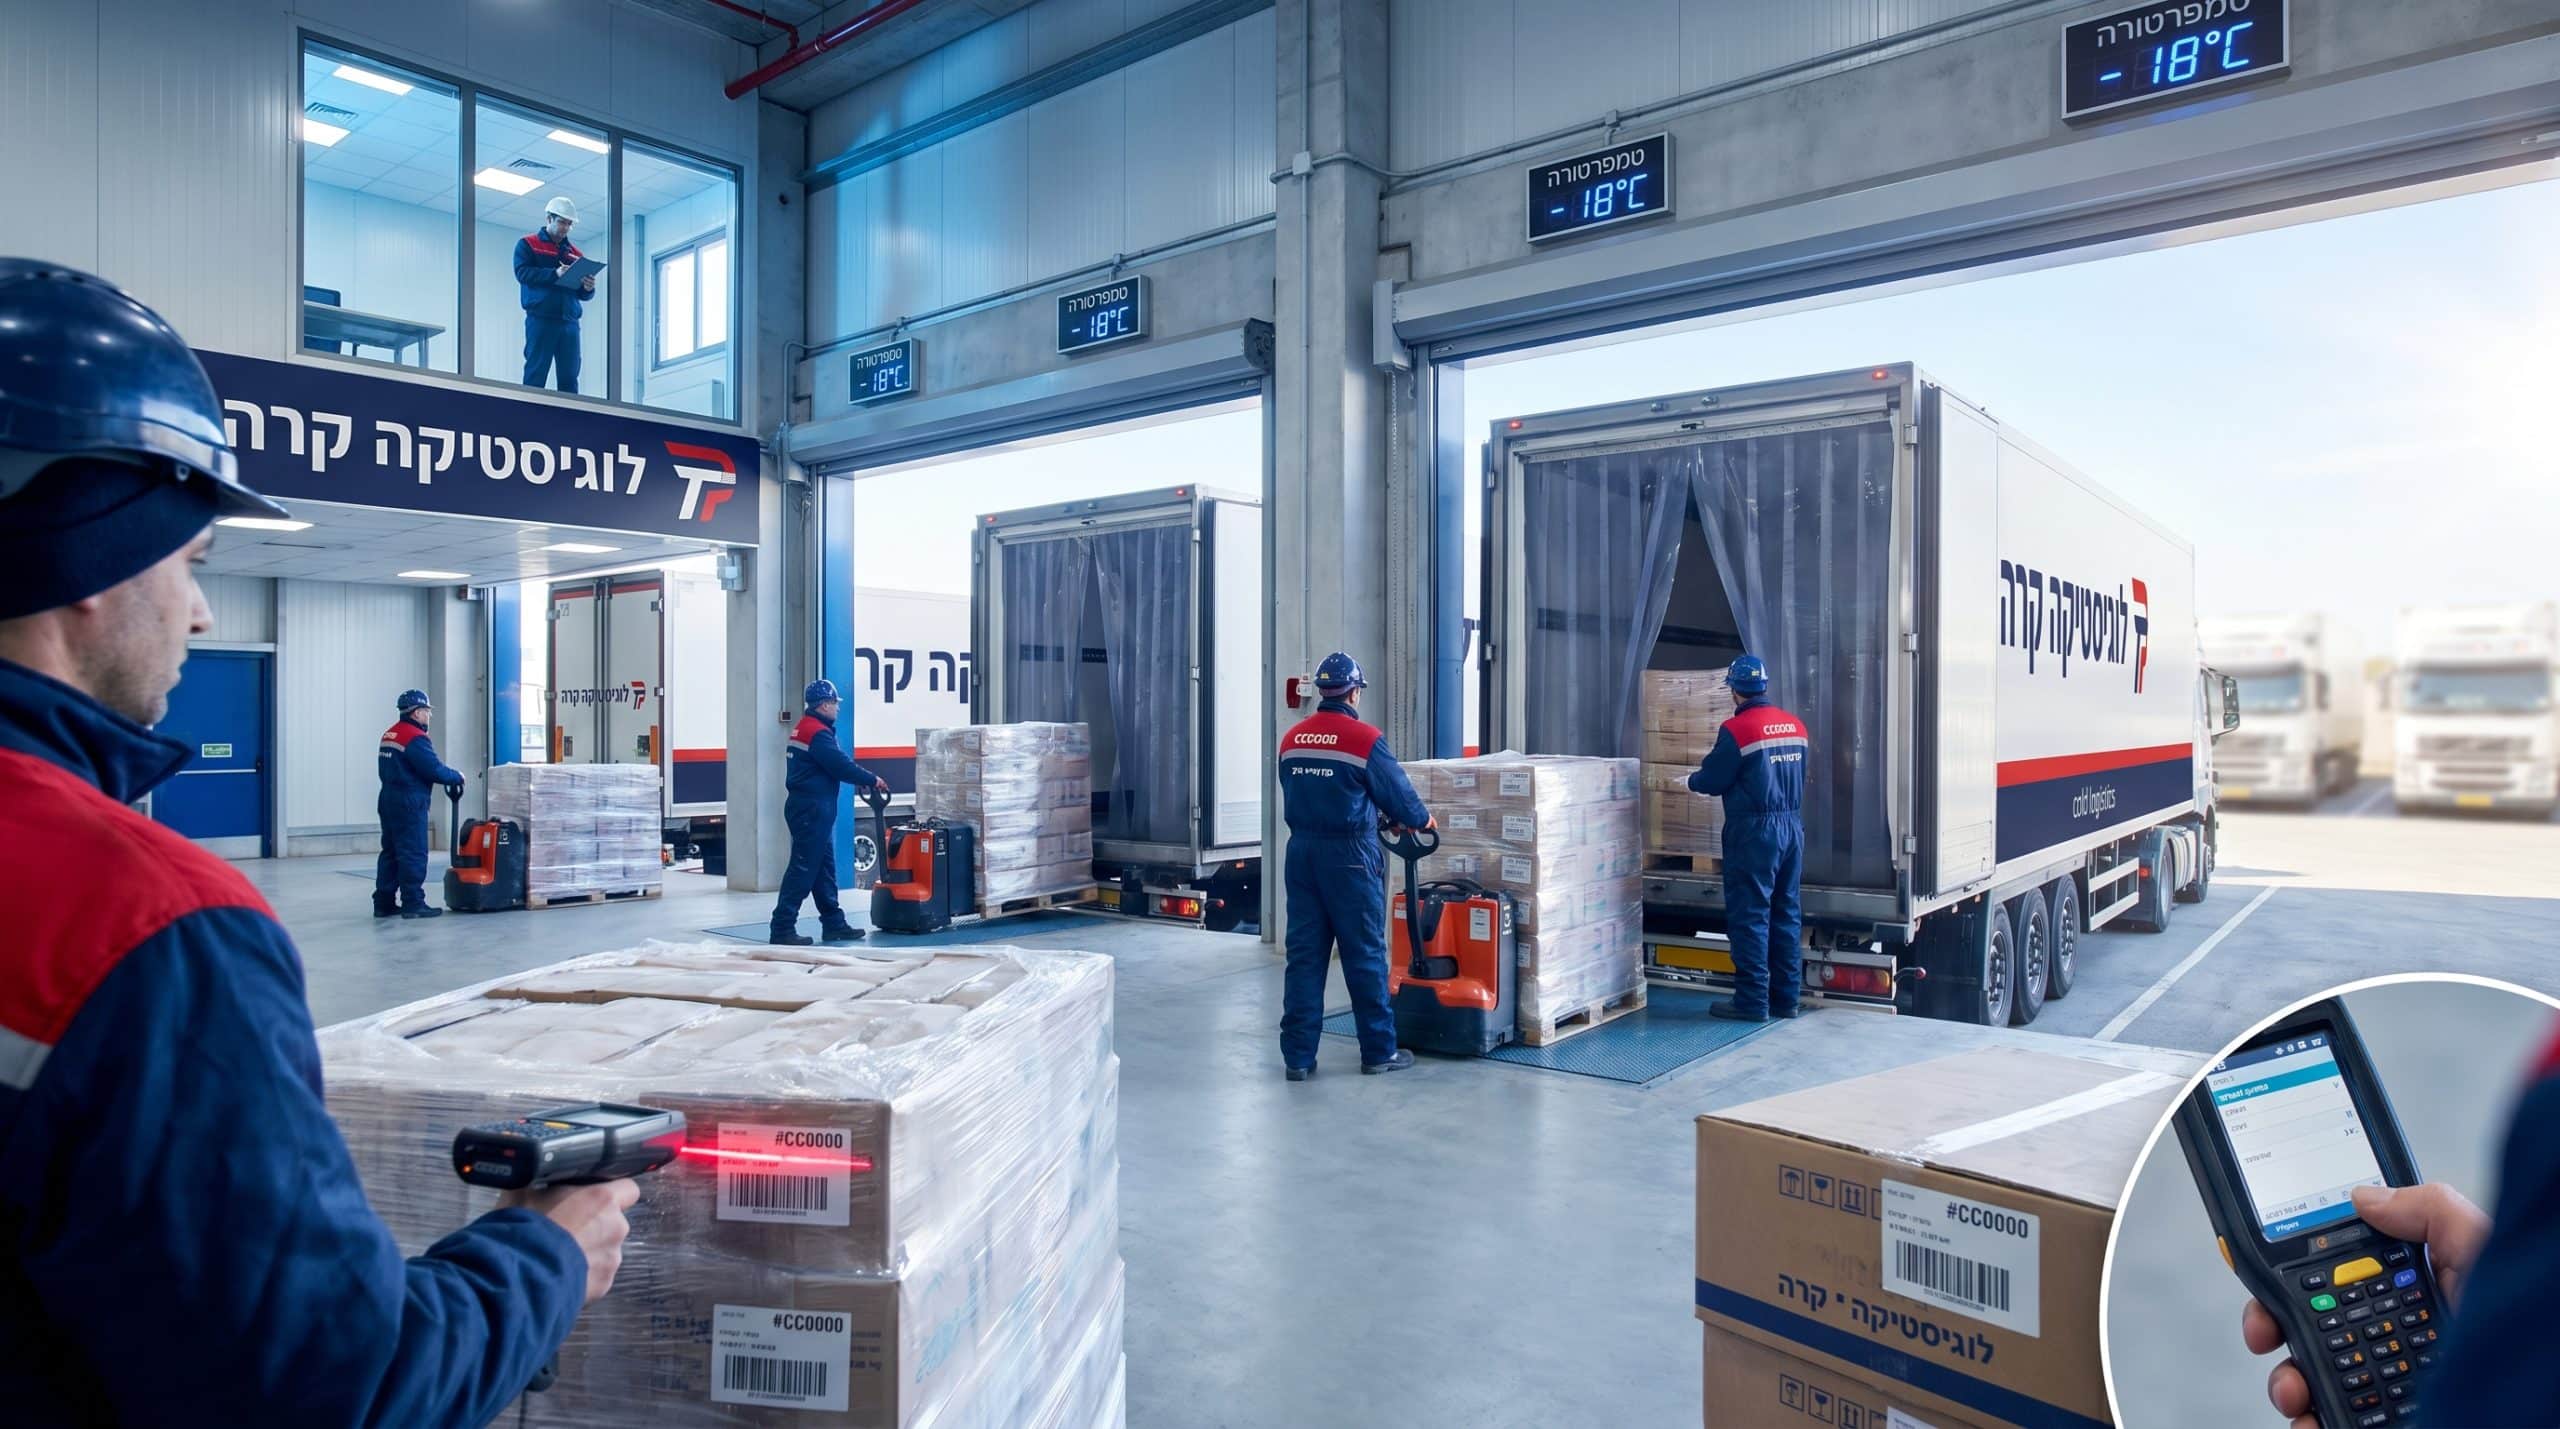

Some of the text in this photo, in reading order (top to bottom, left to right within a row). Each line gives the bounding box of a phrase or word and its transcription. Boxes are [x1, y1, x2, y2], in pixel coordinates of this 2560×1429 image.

[1547, 148, 1645, 188] טמפרטורה
[223, 398, 647, 495] לוגיסטיקה קרה
[2000, 559, 2128, 679] לוגיסטיקה קרה
[561, 689, 580, 707] קרה
[2072, 783, 2116, 820] cold logistics
[775, 1130, 843, 1149] #CC0000
[1946, 1200, 2029, 1239] #CC0000
[1777, 1272, 1828, 1312] קרה
[772, 1312, 844, 1334] #CC0000
[1851, 1297, 1995, 1365] לוגיסטיקה
